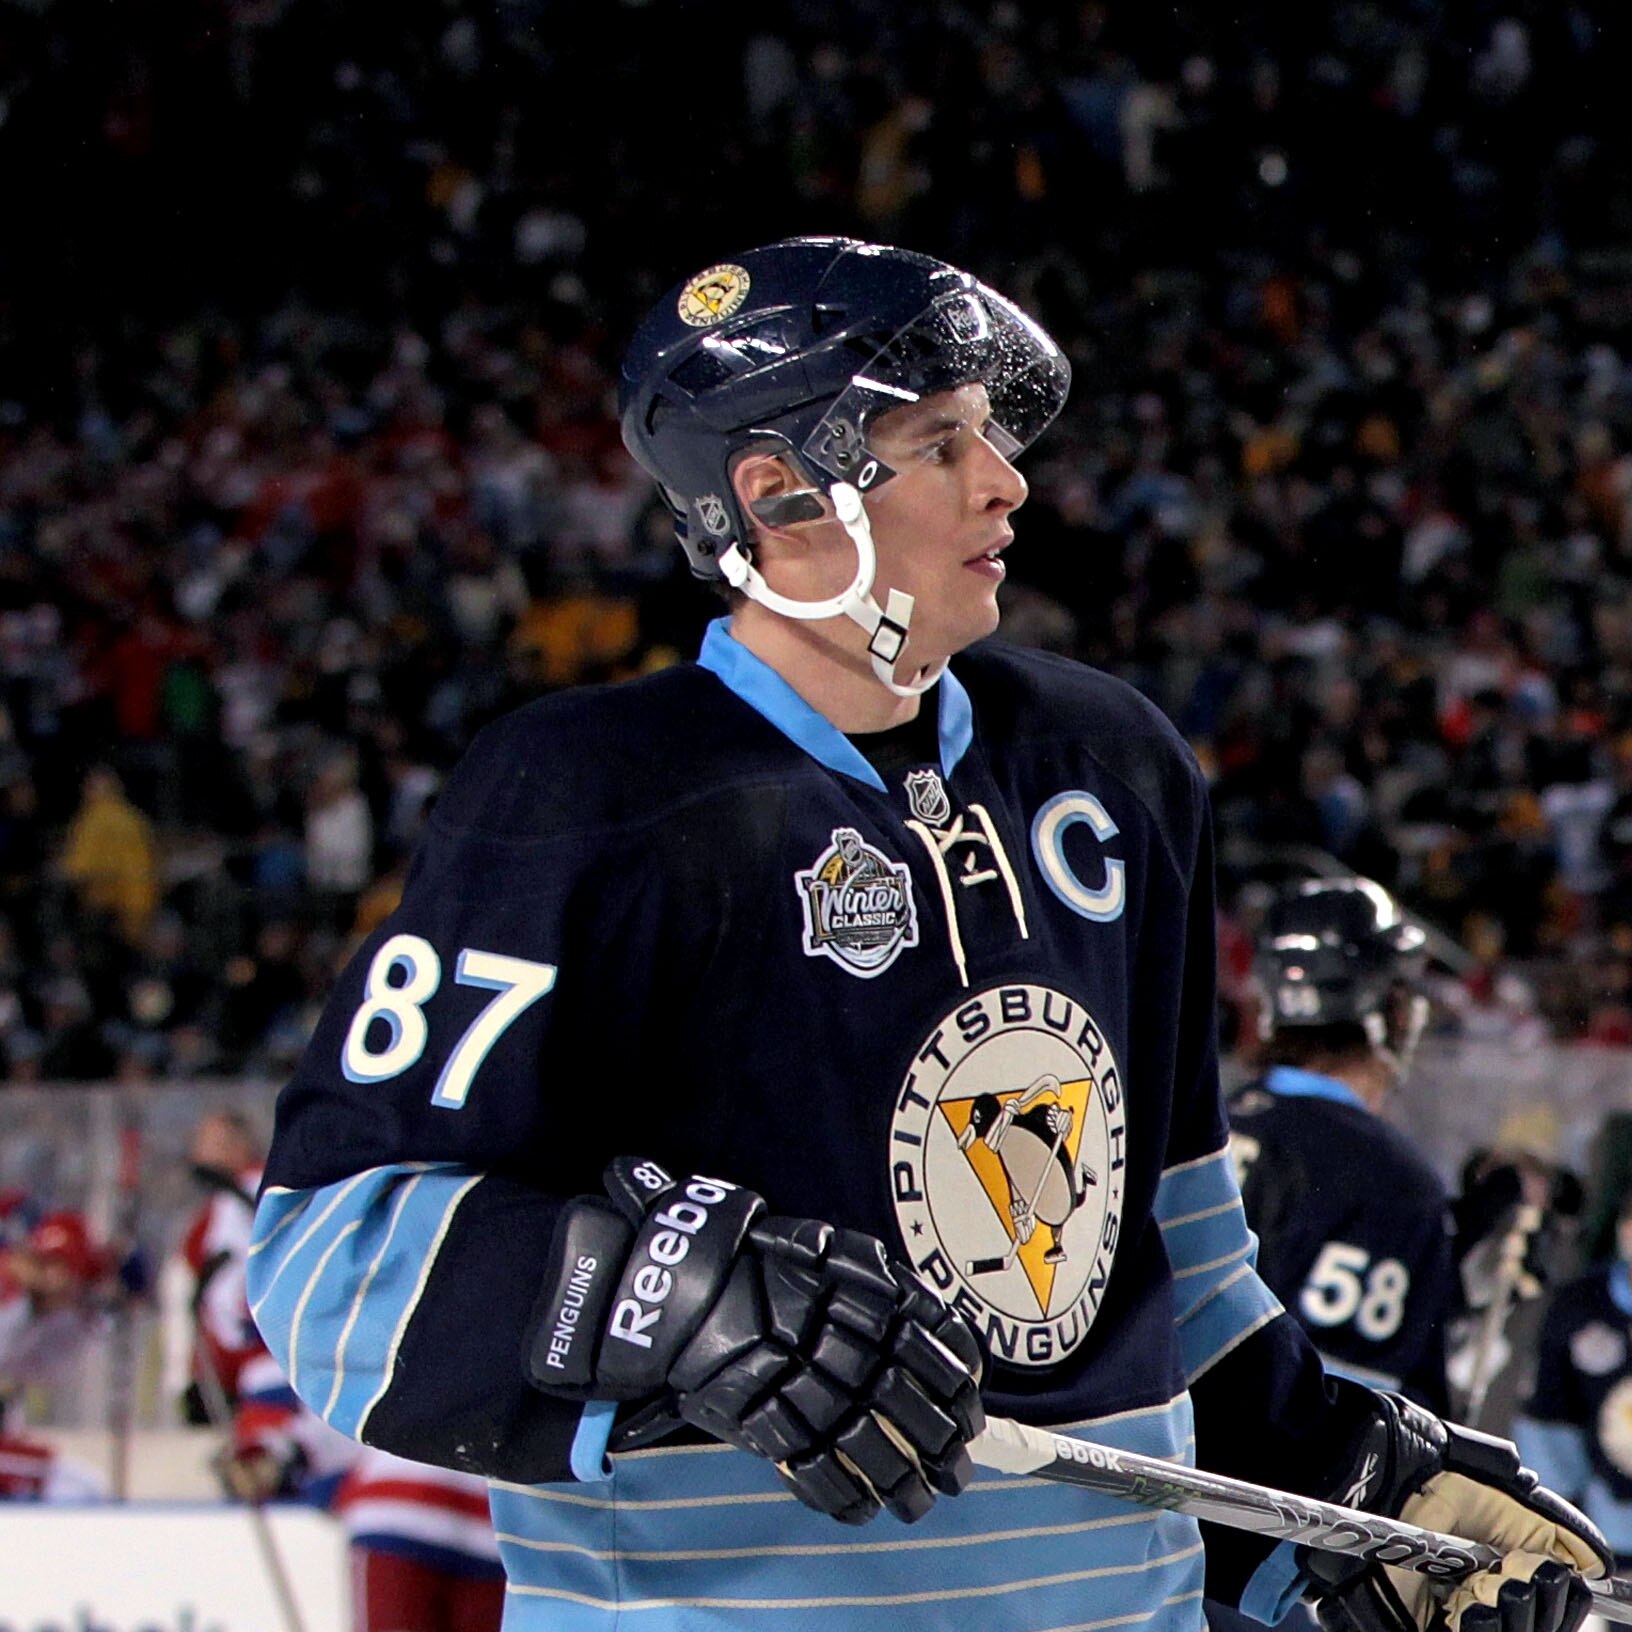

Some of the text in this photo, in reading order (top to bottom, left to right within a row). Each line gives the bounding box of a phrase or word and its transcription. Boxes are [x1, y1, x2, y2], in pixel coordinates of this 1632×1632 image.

[811, 880, 901, 930] Winter
[1032, 791, 1125, 923] C
[831, 911, 896, 930] CLASSIC
[340, 934, 556, 1109] 87
[895, 988, 1125, 1203] PITTSBURGH
[632, 1161, 672, 1191] 87
[546, 1255, 598, 1370] PENGUINS
[610, 1174, 738, 1349] Reebo
[919, 1210, 1117, 1361] PENGUINS
[1301, 1242, 1408, 1340] 58
[1056, 1438, 1124, 1473] ebok
